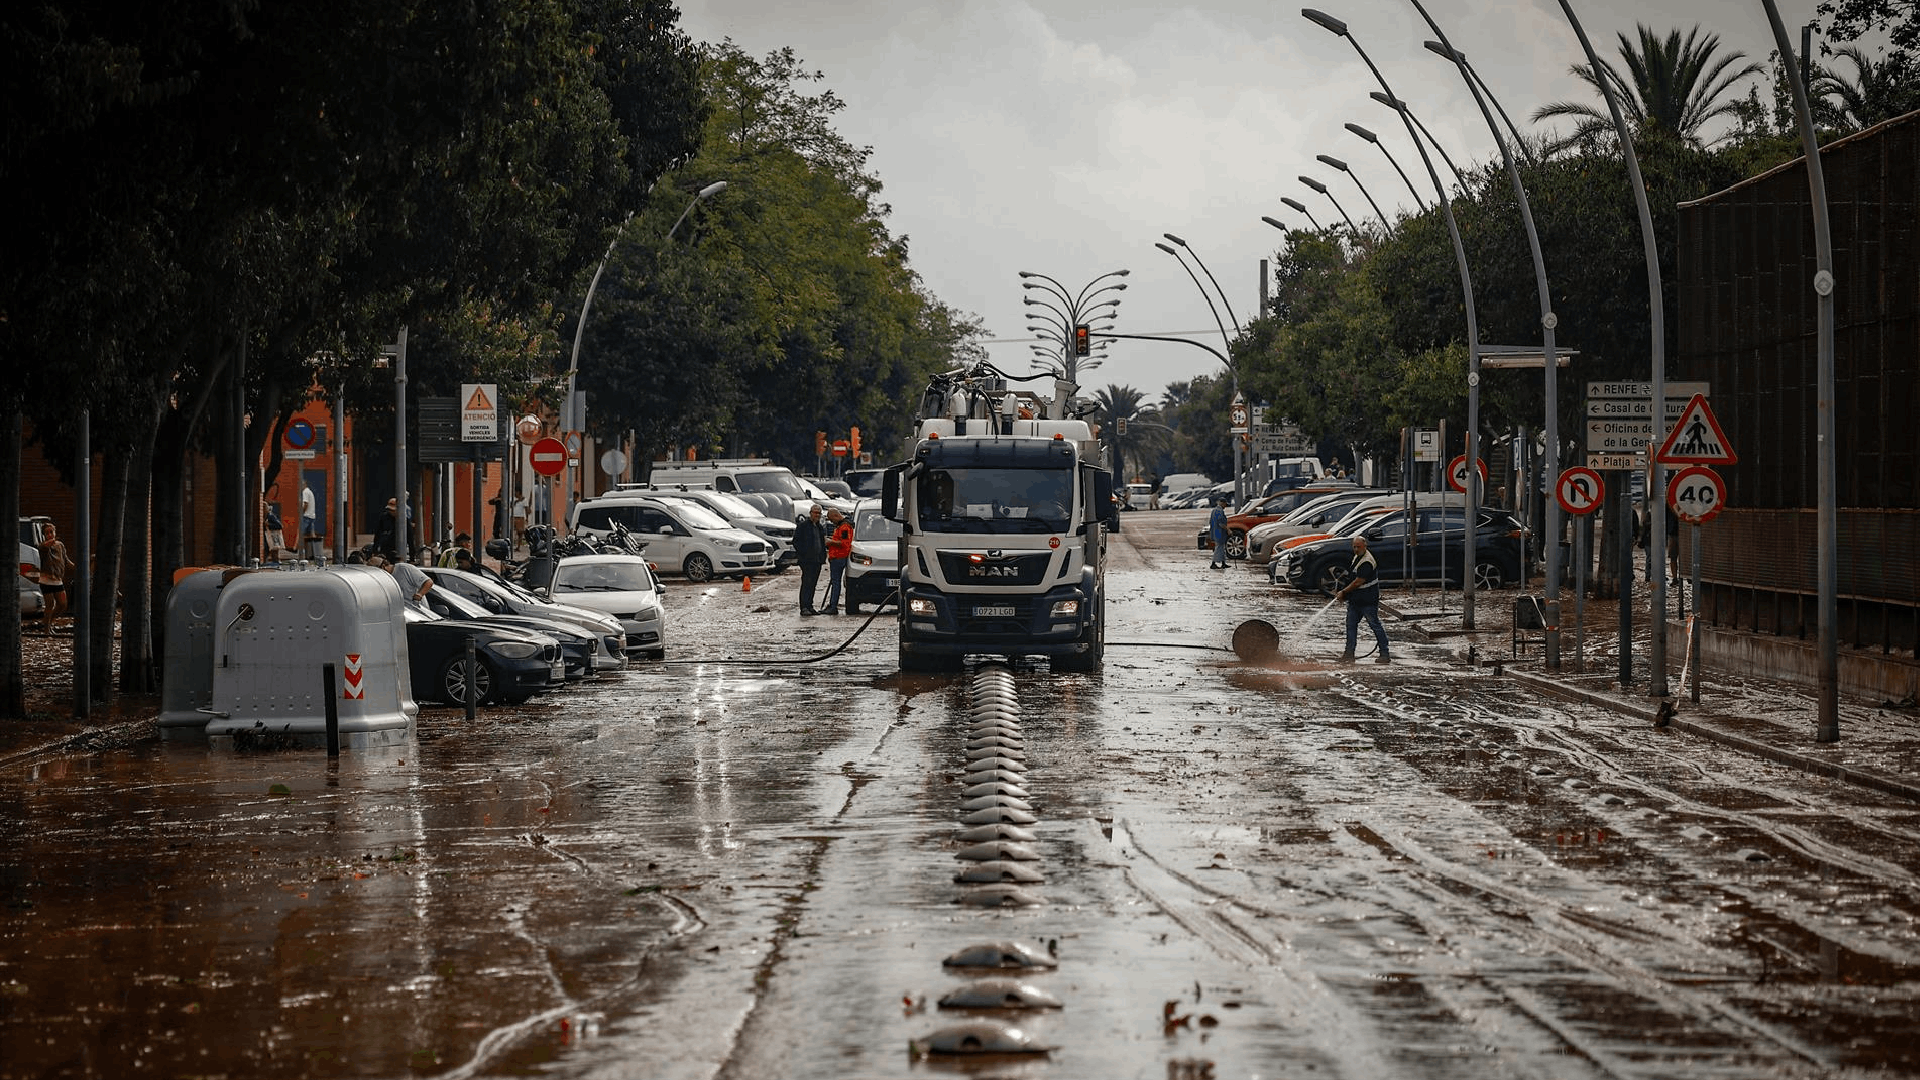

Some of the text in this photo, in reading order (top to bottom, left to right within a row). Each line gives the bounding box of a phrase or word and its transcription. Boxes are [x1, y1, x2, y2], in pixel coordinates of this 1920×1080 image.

[1604, 385, 1637, 394] RENFE
[1604, 403, 1631, 413] Casal
[1634, 403, 1646, 413] de
[1604, 424, 1652, 433] Oficina de
[1604, 437, 1616, 447] de
[1619, 437, 1628, 447] la
[1603, 457, 1631, 467] Platja
[1680, 486, 1714, 504] 40
[969, 566, 1019, 577] MAN
[978, 607, 997, 616] 0721
